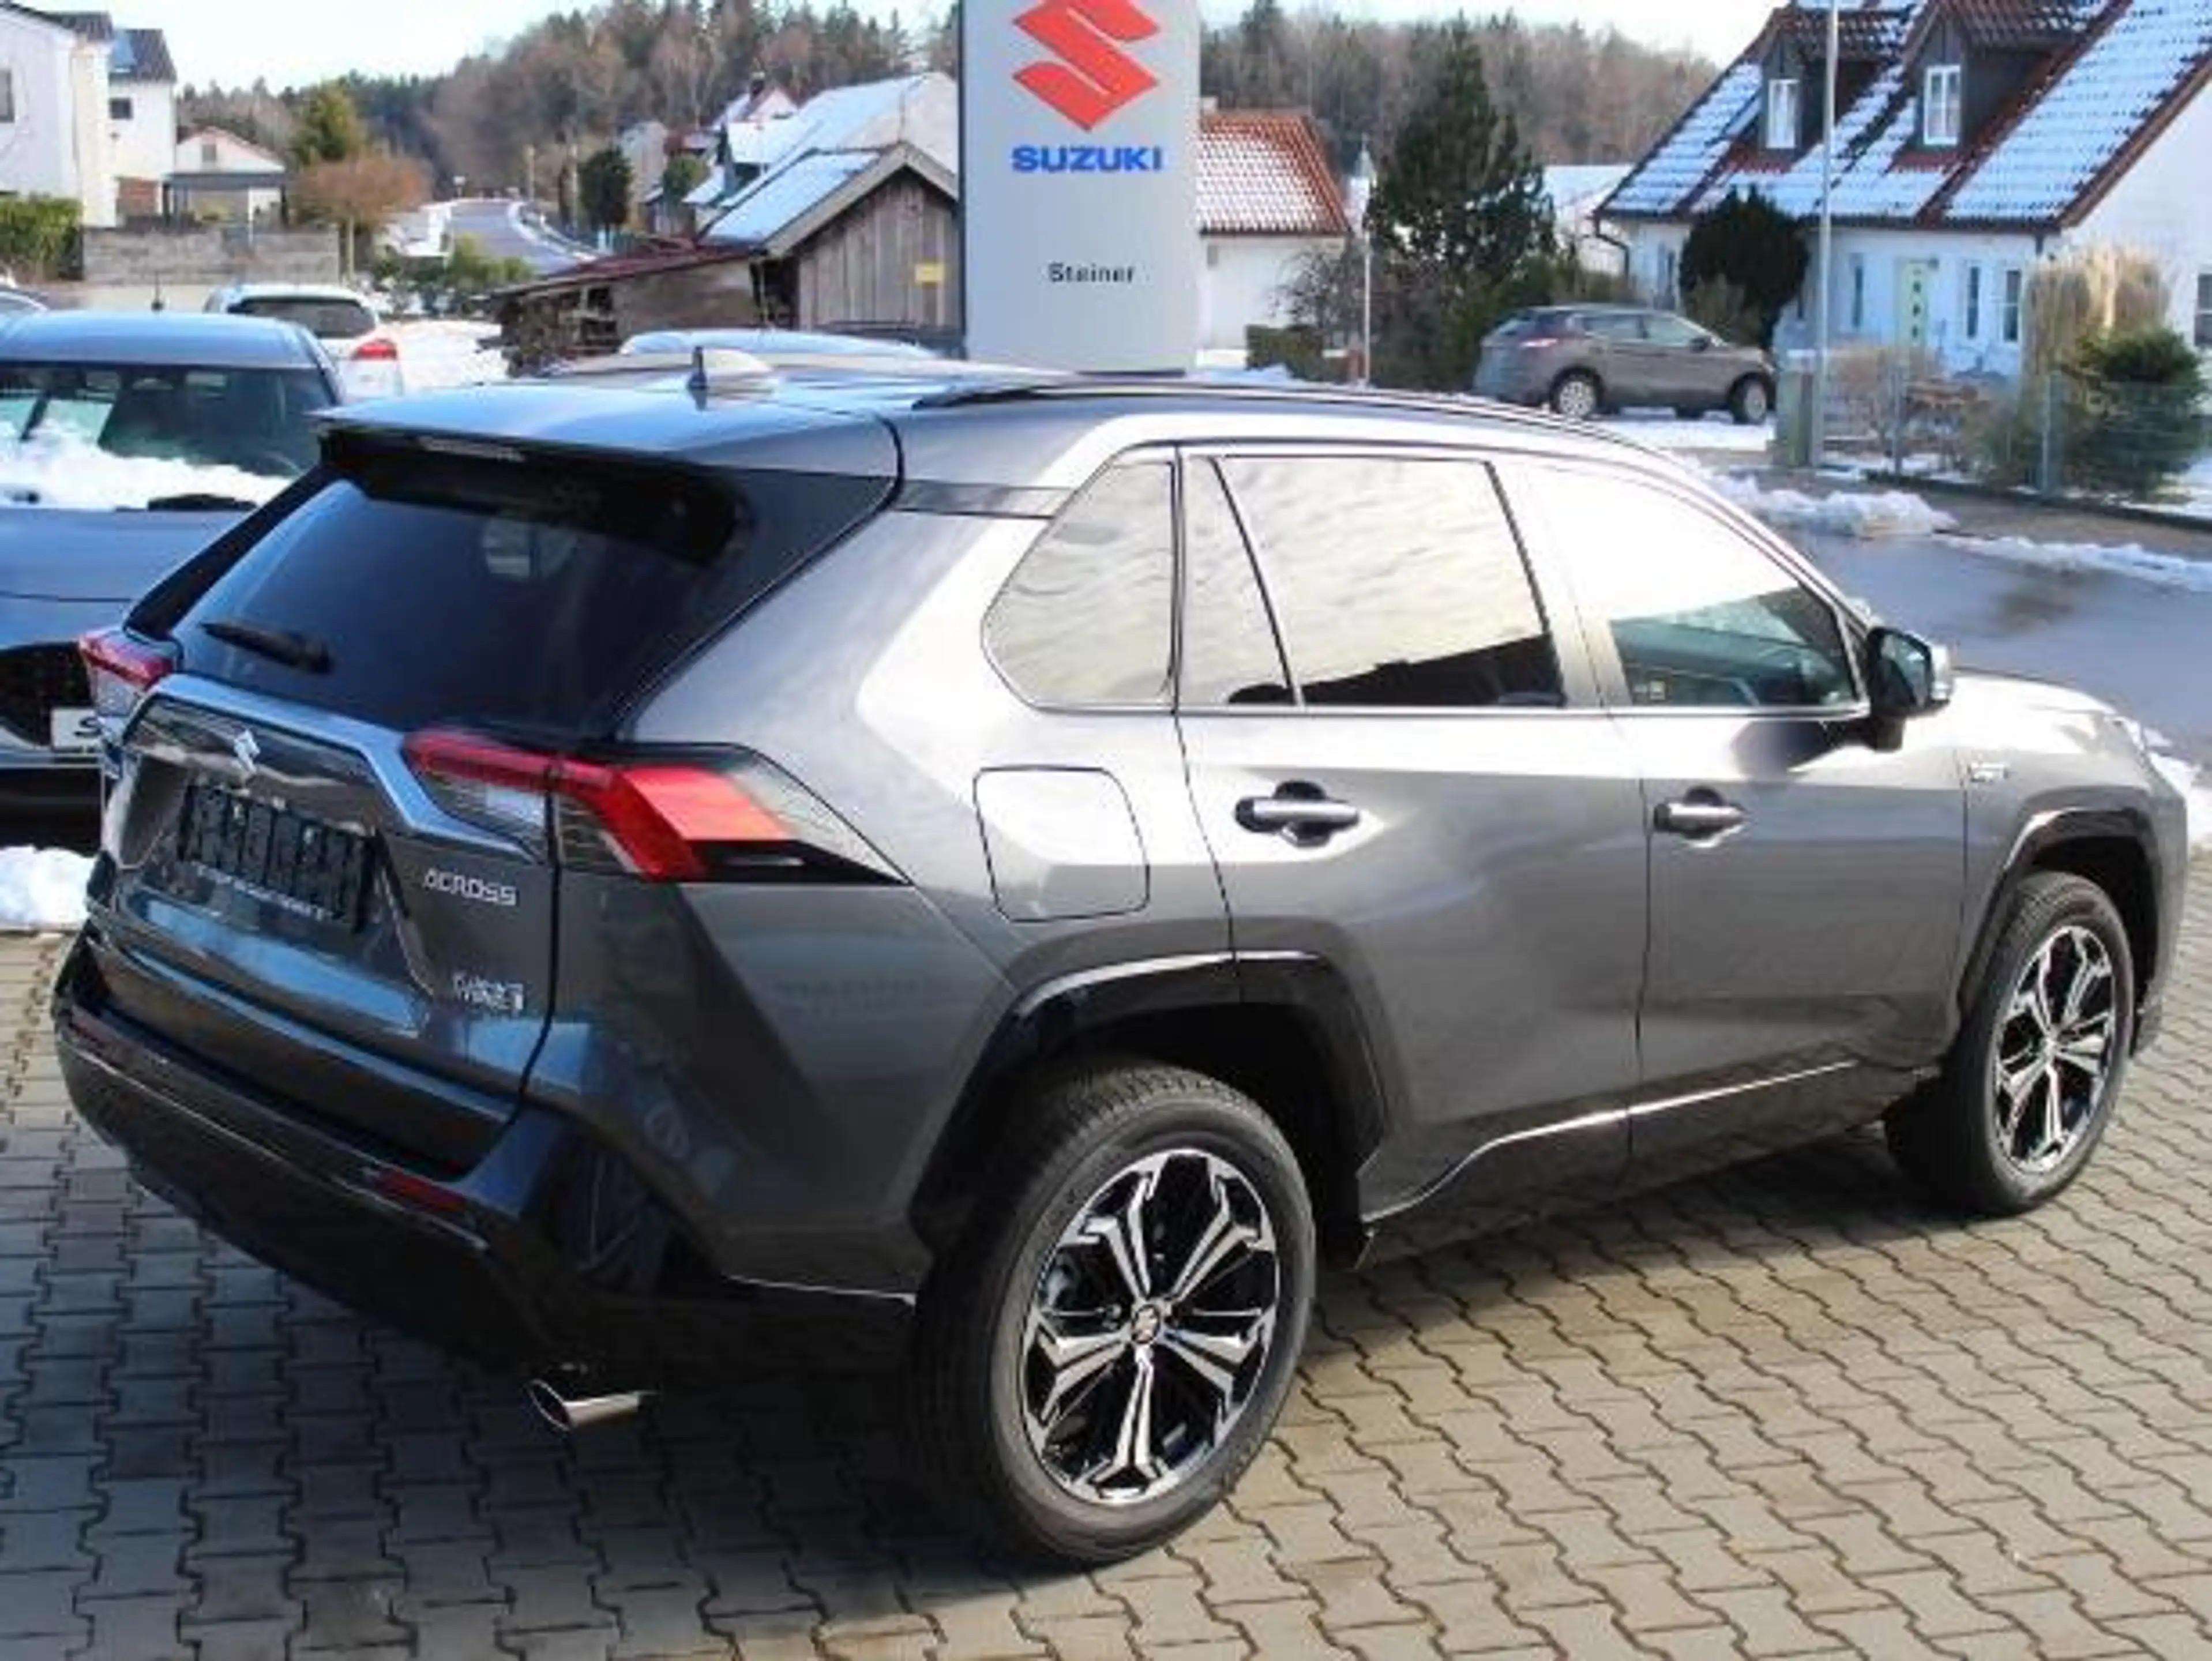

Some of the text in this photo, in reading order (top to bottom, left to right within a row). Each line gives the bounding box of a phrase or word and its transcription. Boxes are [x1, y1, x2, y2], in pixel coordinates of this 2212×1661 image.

[1012, 146, 1163, 172] SUZUKI
[1049, 263, 1135, 283] Steiner
[423, 867, 517, 906] ACROSS
